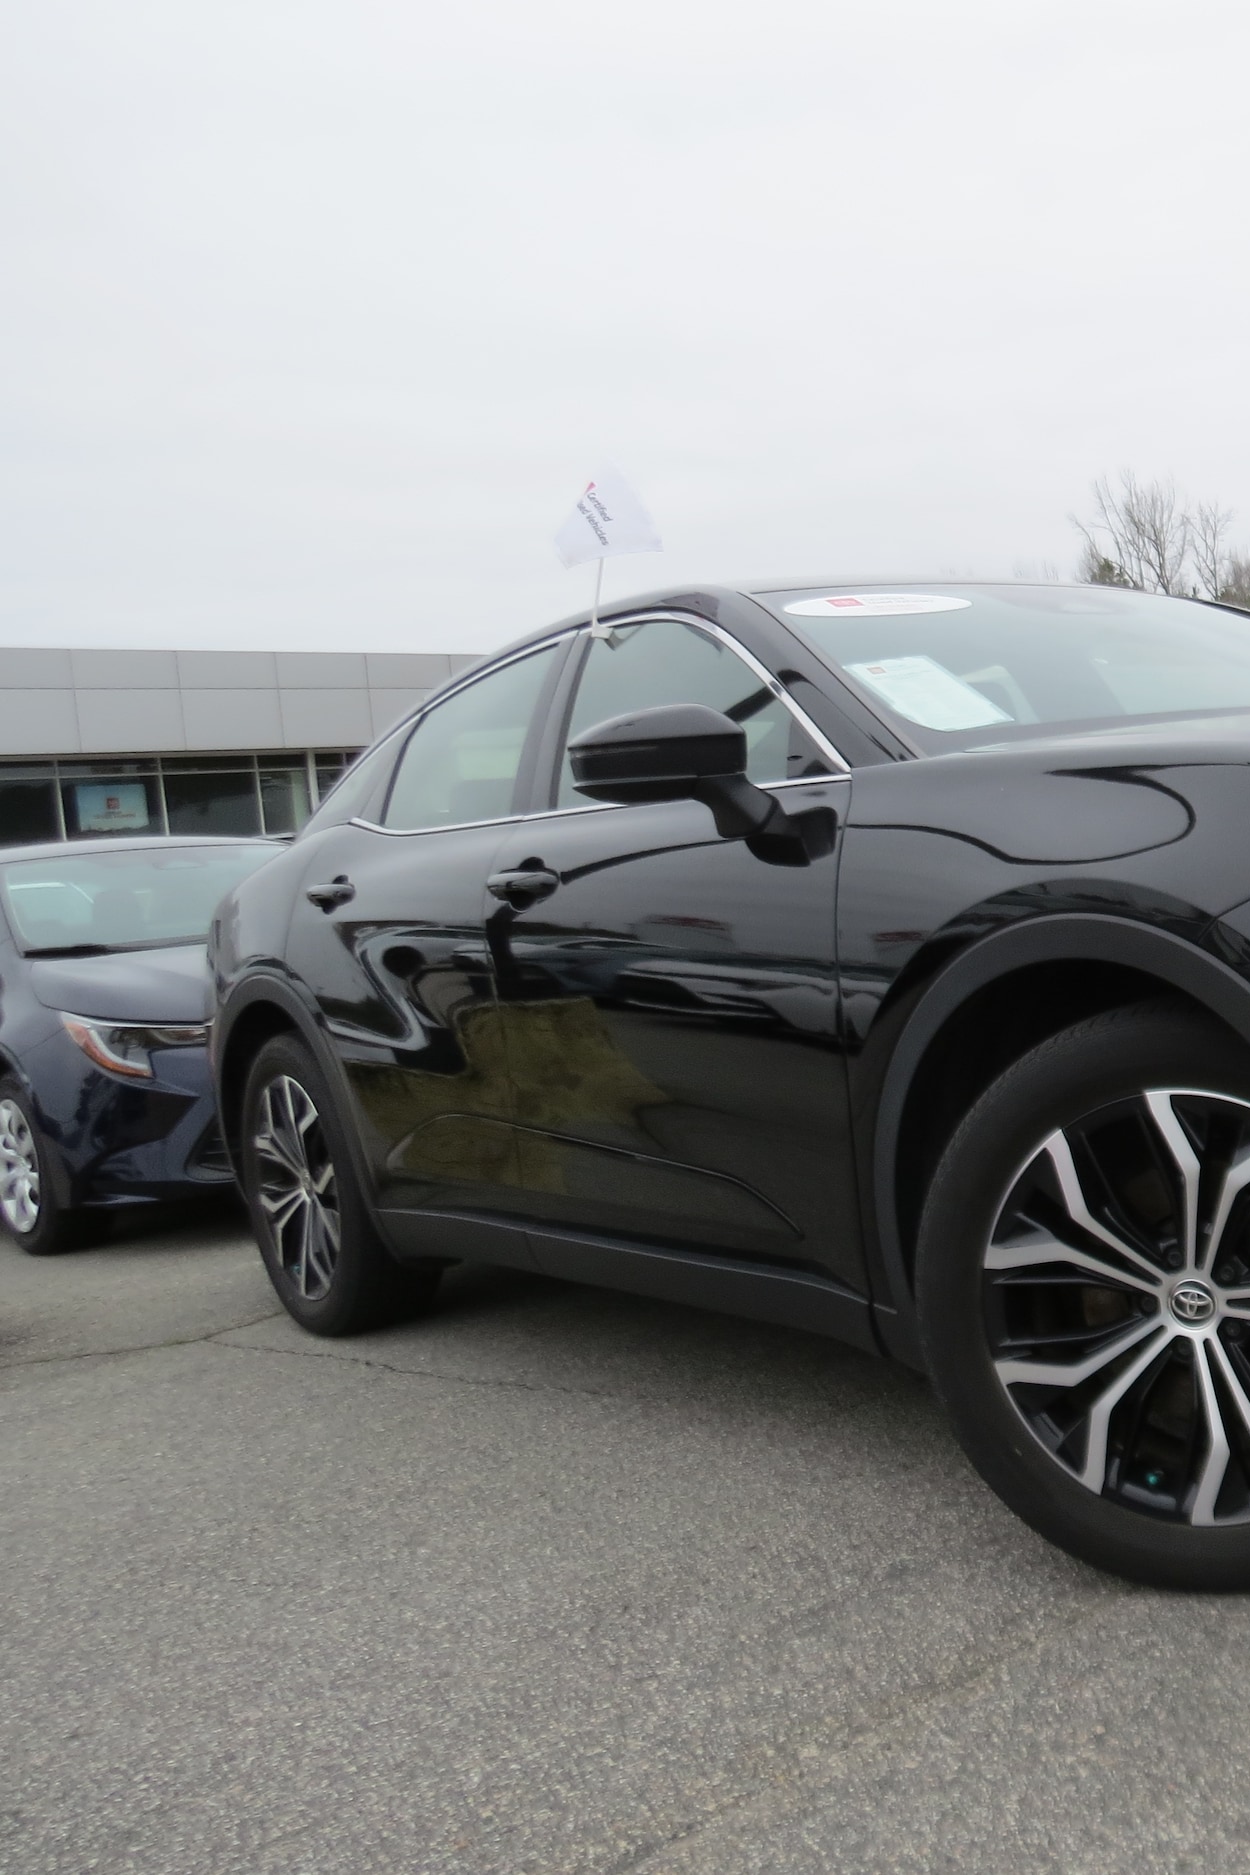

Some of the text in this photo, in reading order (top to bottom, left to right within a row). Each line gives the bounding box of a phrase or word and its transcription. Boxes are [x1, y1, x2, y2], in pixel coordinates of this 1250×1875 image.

[576, 500, 610, 546] sed Vehicles
[587, 492, 613, 522] Certified
